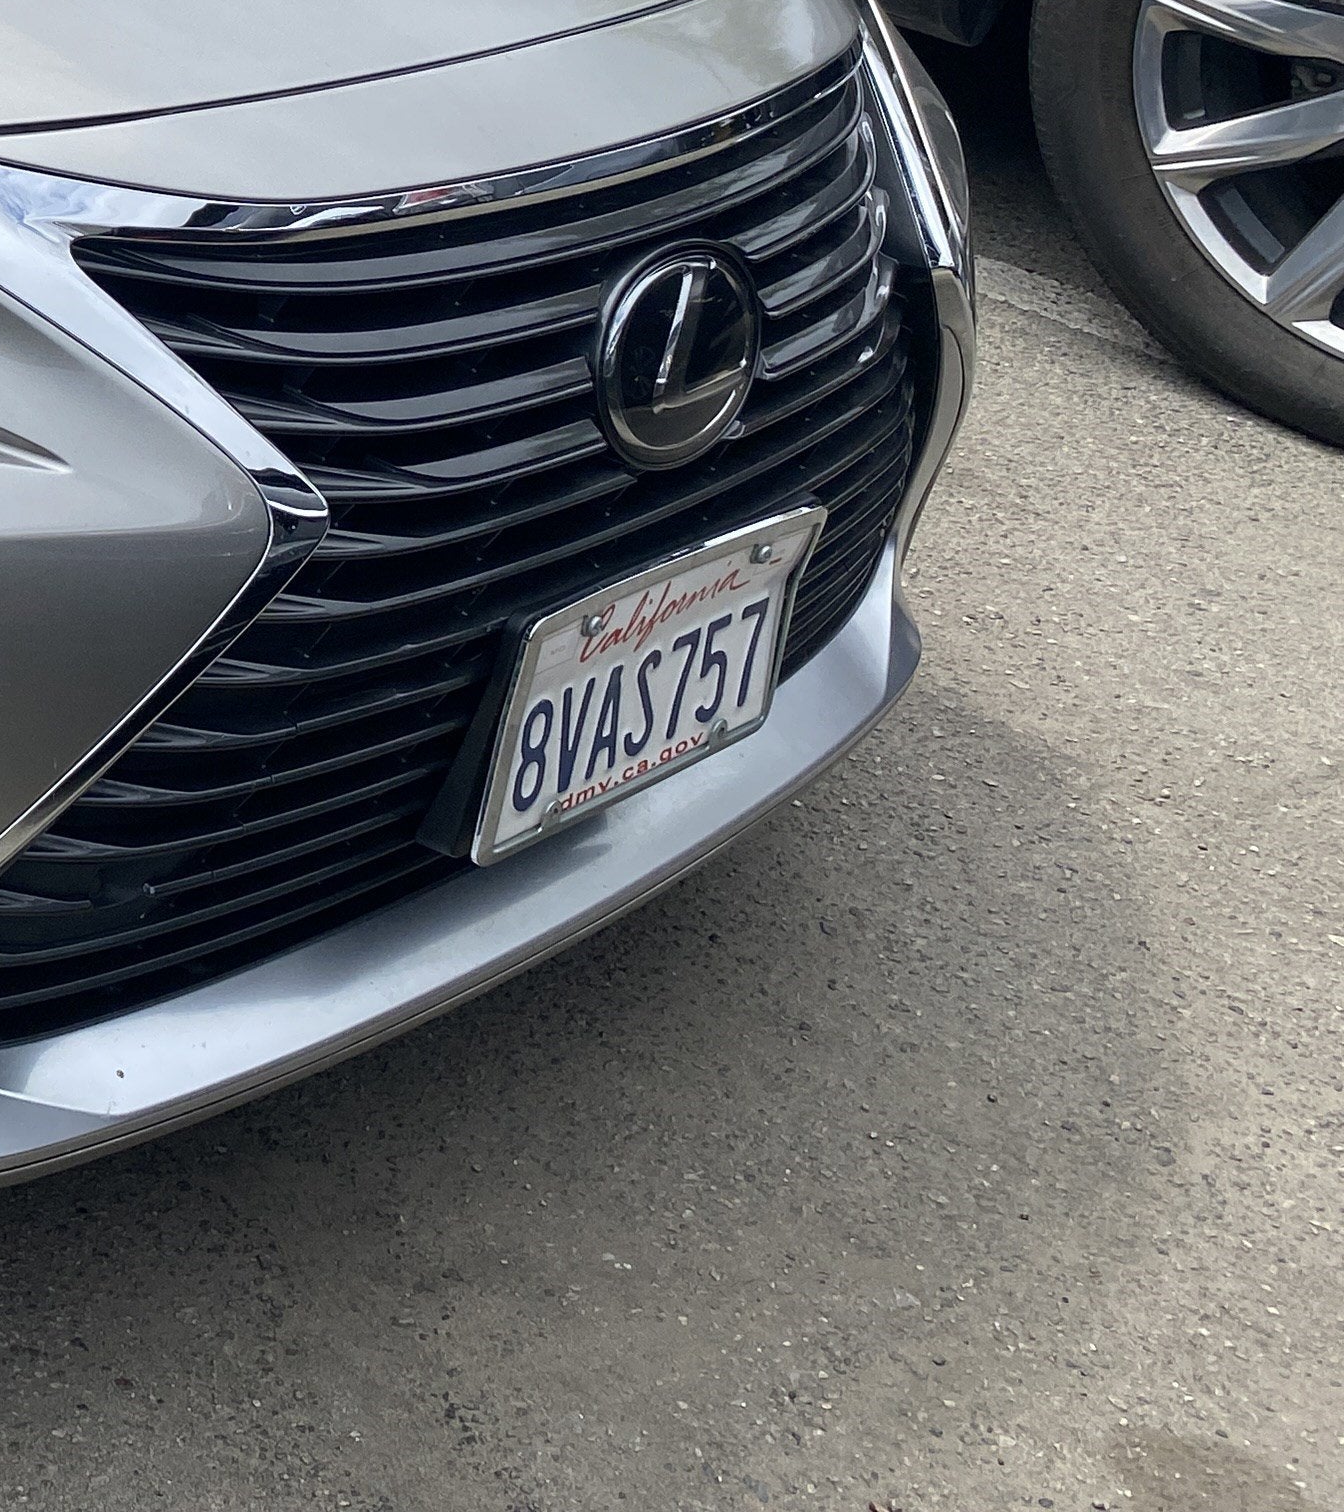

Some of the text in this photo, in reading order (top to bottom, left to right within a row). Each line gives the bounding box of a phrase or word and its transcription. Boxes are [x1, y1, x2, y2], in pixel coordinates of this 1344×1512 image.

[580, 562, 750, 662] California
[512, 597, 770, 813] 8VAS757
[561, 732, 704, 811] dmv.ca.gov
